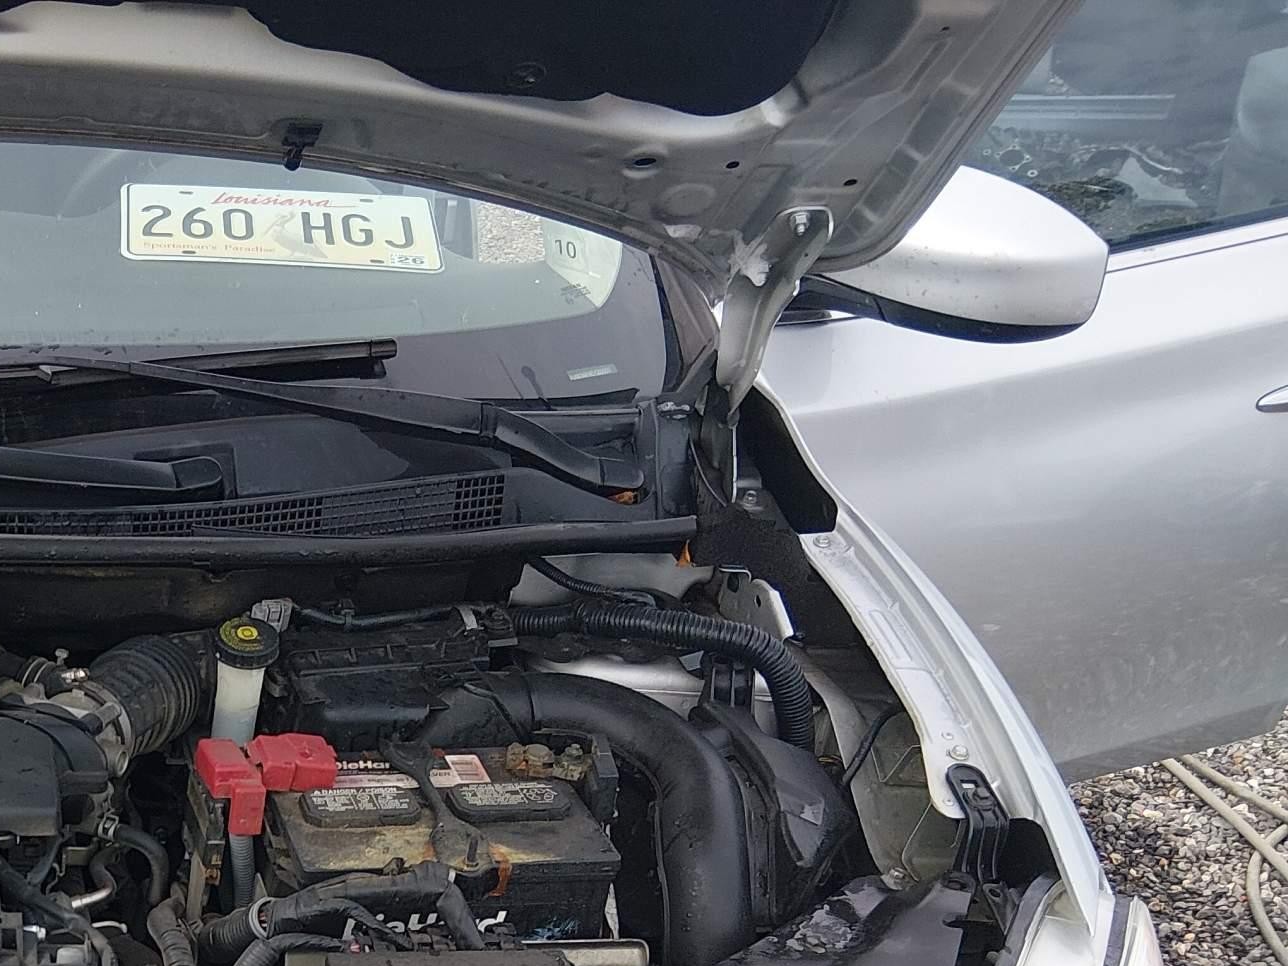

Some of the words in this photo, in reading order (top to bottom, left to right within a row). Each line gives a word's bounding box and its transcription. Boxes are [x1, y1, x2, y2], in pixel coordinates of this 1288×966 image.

[211, 192, 355, 208] Louisiana
[141, 205, 254, 241] 260
[301, 212, 415, 249] HGJ
[555, 239, 577, 259] 10
[397, 256, 425, 265] 26
